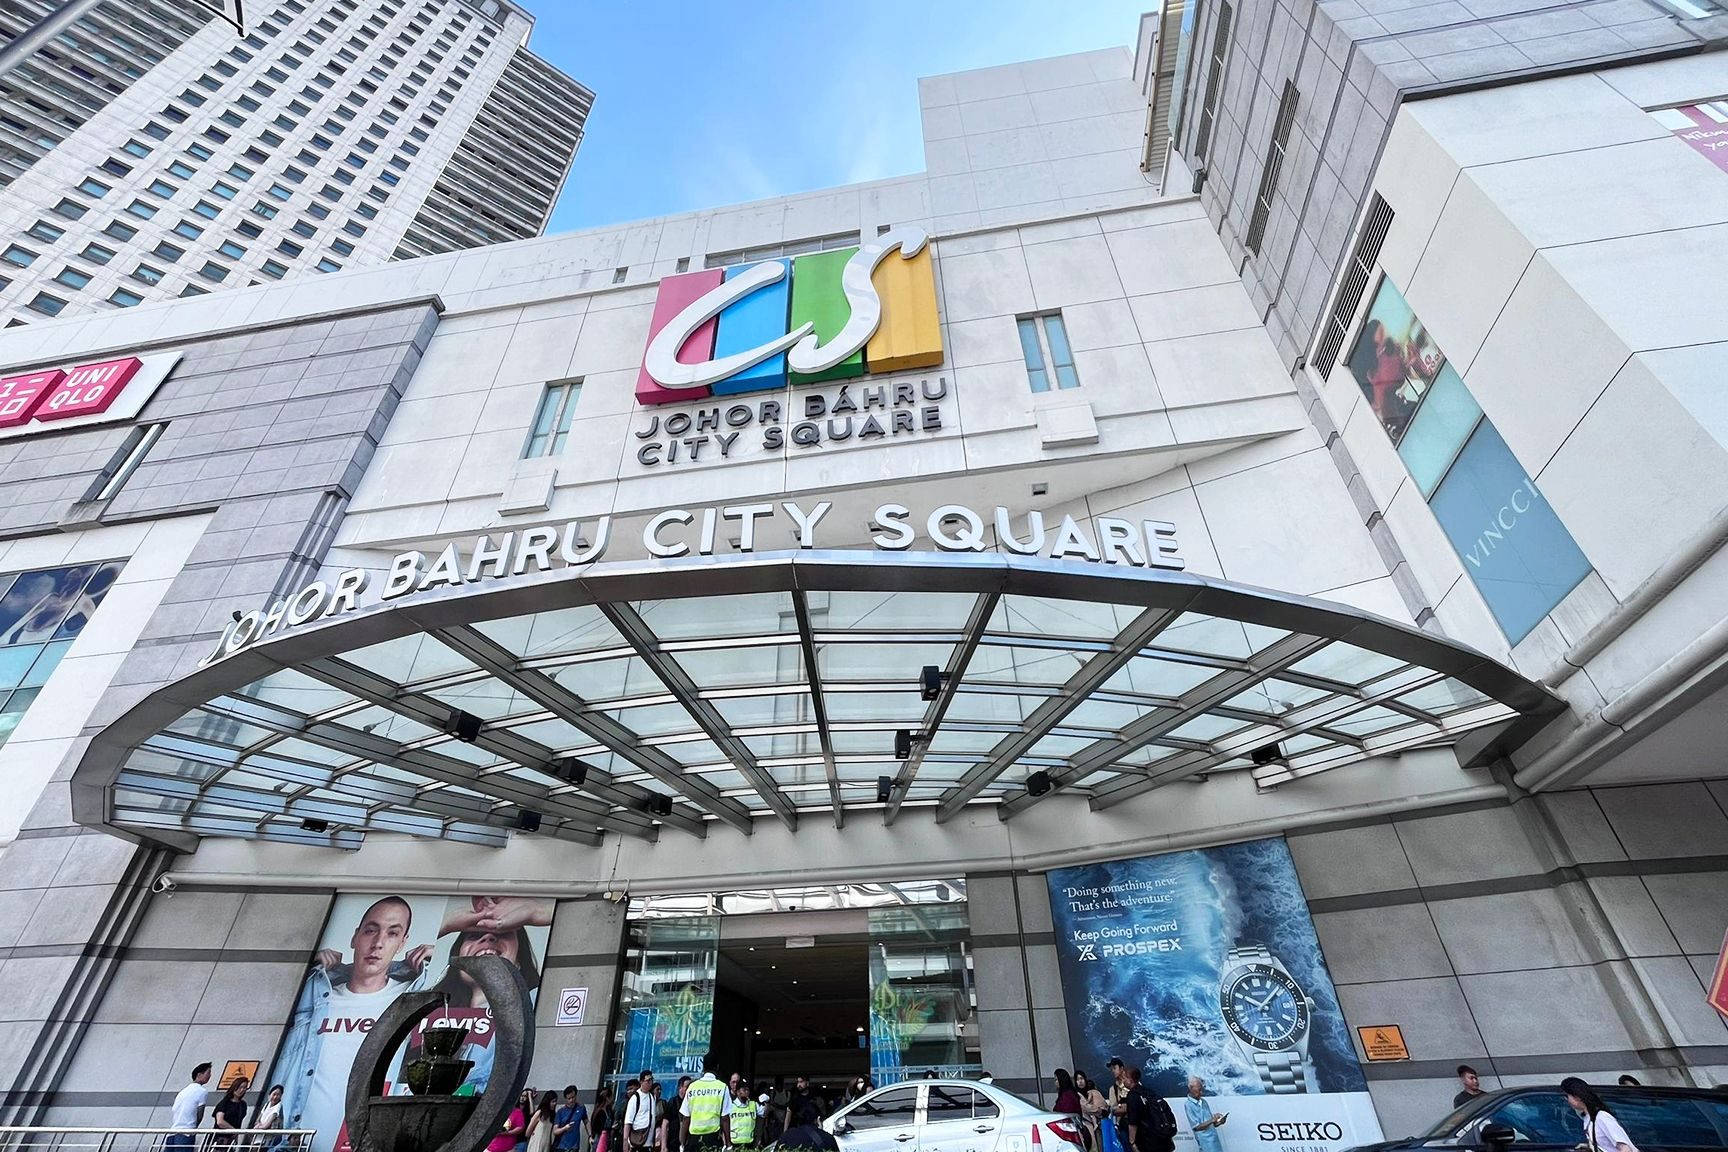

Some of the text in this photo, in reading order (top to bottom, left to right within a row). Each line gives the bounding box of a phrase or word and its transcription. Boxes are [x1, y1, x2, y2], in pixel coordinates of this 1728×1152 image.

[66, 365, 119, 388] UNI
[48, 385, 105, 410] QLO
[635, 377, 947, 439] JOHOR BAHRU
[637, 405, 942, 466] CITY SQUARE
[1465, 478, 1539, 568] VINCCI
[197, 502, 1186, 668] JOHOR BAHRU CITY SQUARE
[1101, 880, 1152, 894] something
[1154, 878, 1177, 887] new.
[1069, 900, 1100, 912] That's
[1103, 899, 1119, 908] the
[1073, 919, 1178, 942] Keep Going Forward
[1102, 938, 1182, 957] PROSPEX
[688, 1088, 722, 1097] SECURITY
[1257, 1122, 1343, 1142] SEIKO
